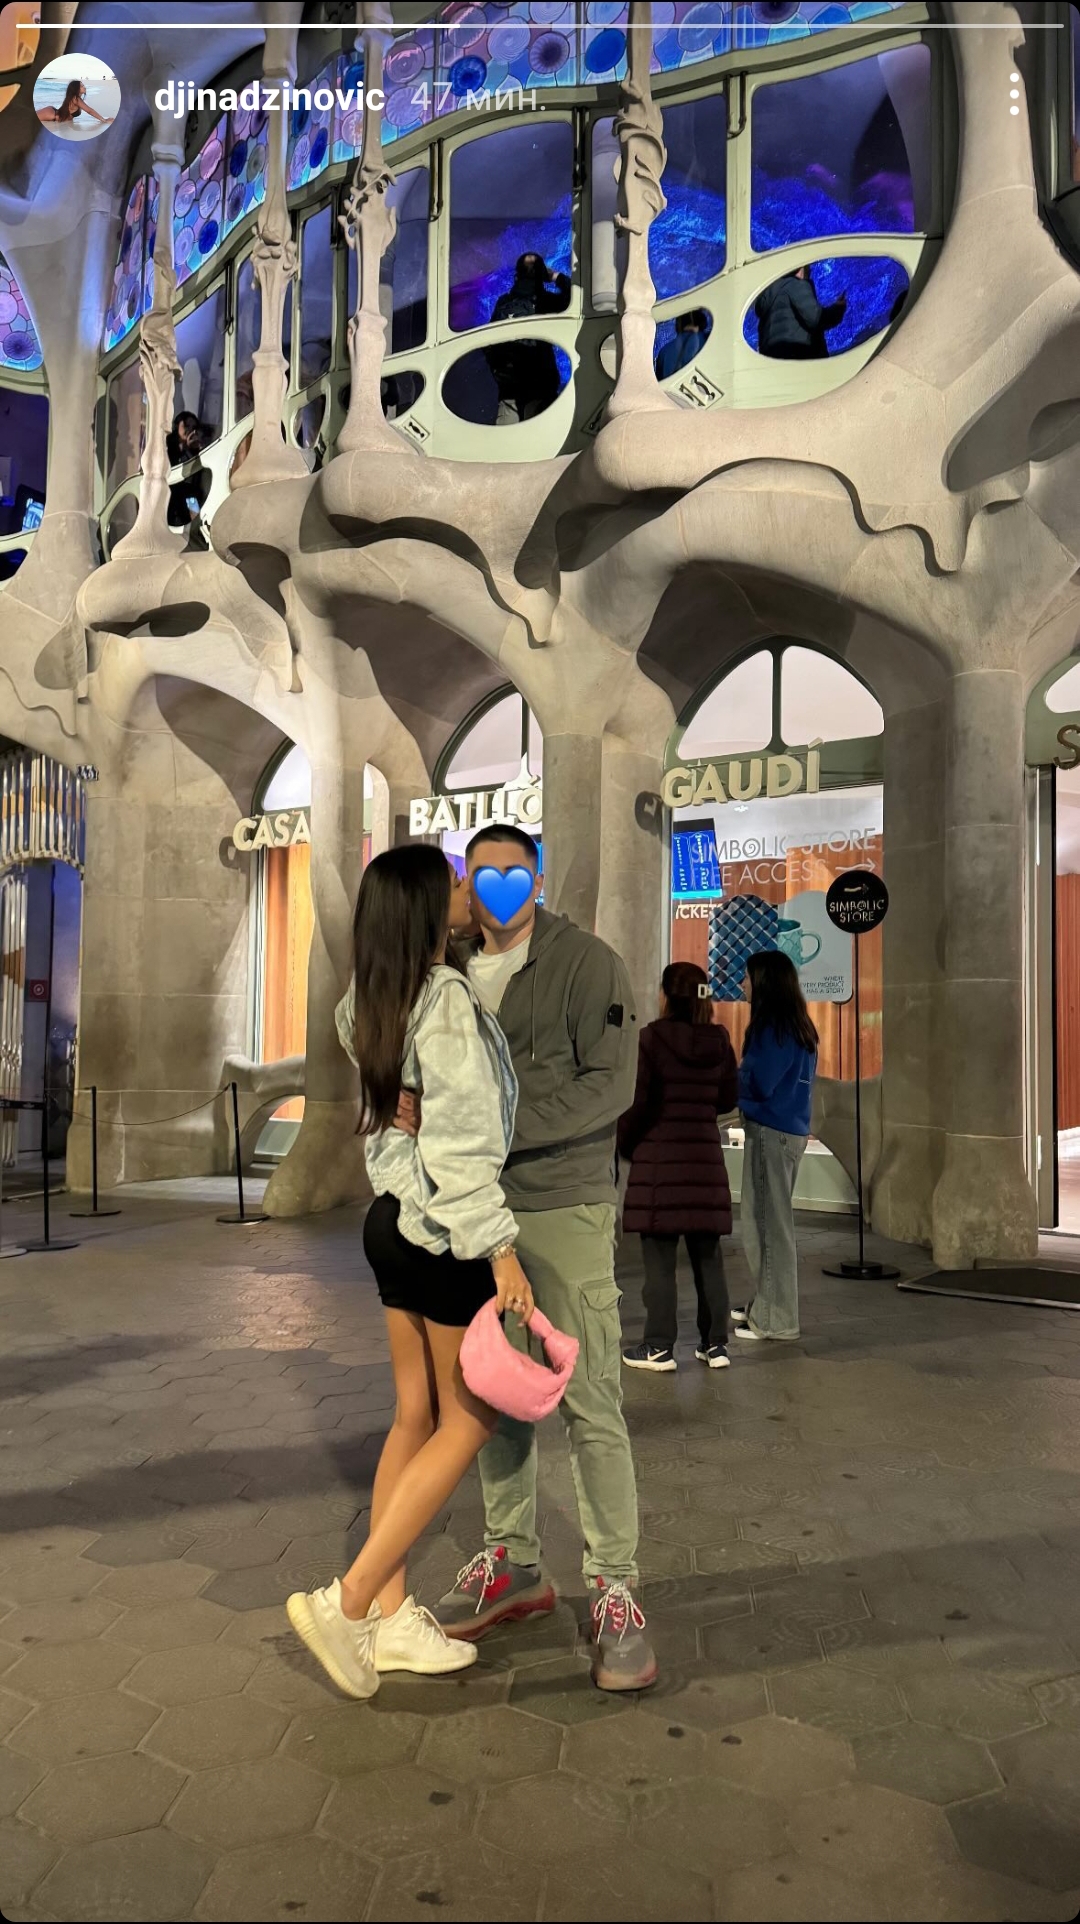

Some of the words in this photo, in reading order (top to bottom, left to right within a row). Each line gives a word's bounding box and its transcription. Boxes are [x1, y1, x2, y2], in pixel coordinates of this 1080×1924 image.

[233, 810, 311, 851] CASA
[409, 774, 543, 836] BATLLÓ
[660, 737, 823, 808] GAUDÍ
[801, 827, 876, 855] STORE
[739, 859, 826, 885] ACCESS
[829, 899, 885, 912] SIMBOLIC
[840, 911, 875, 923] STORE
